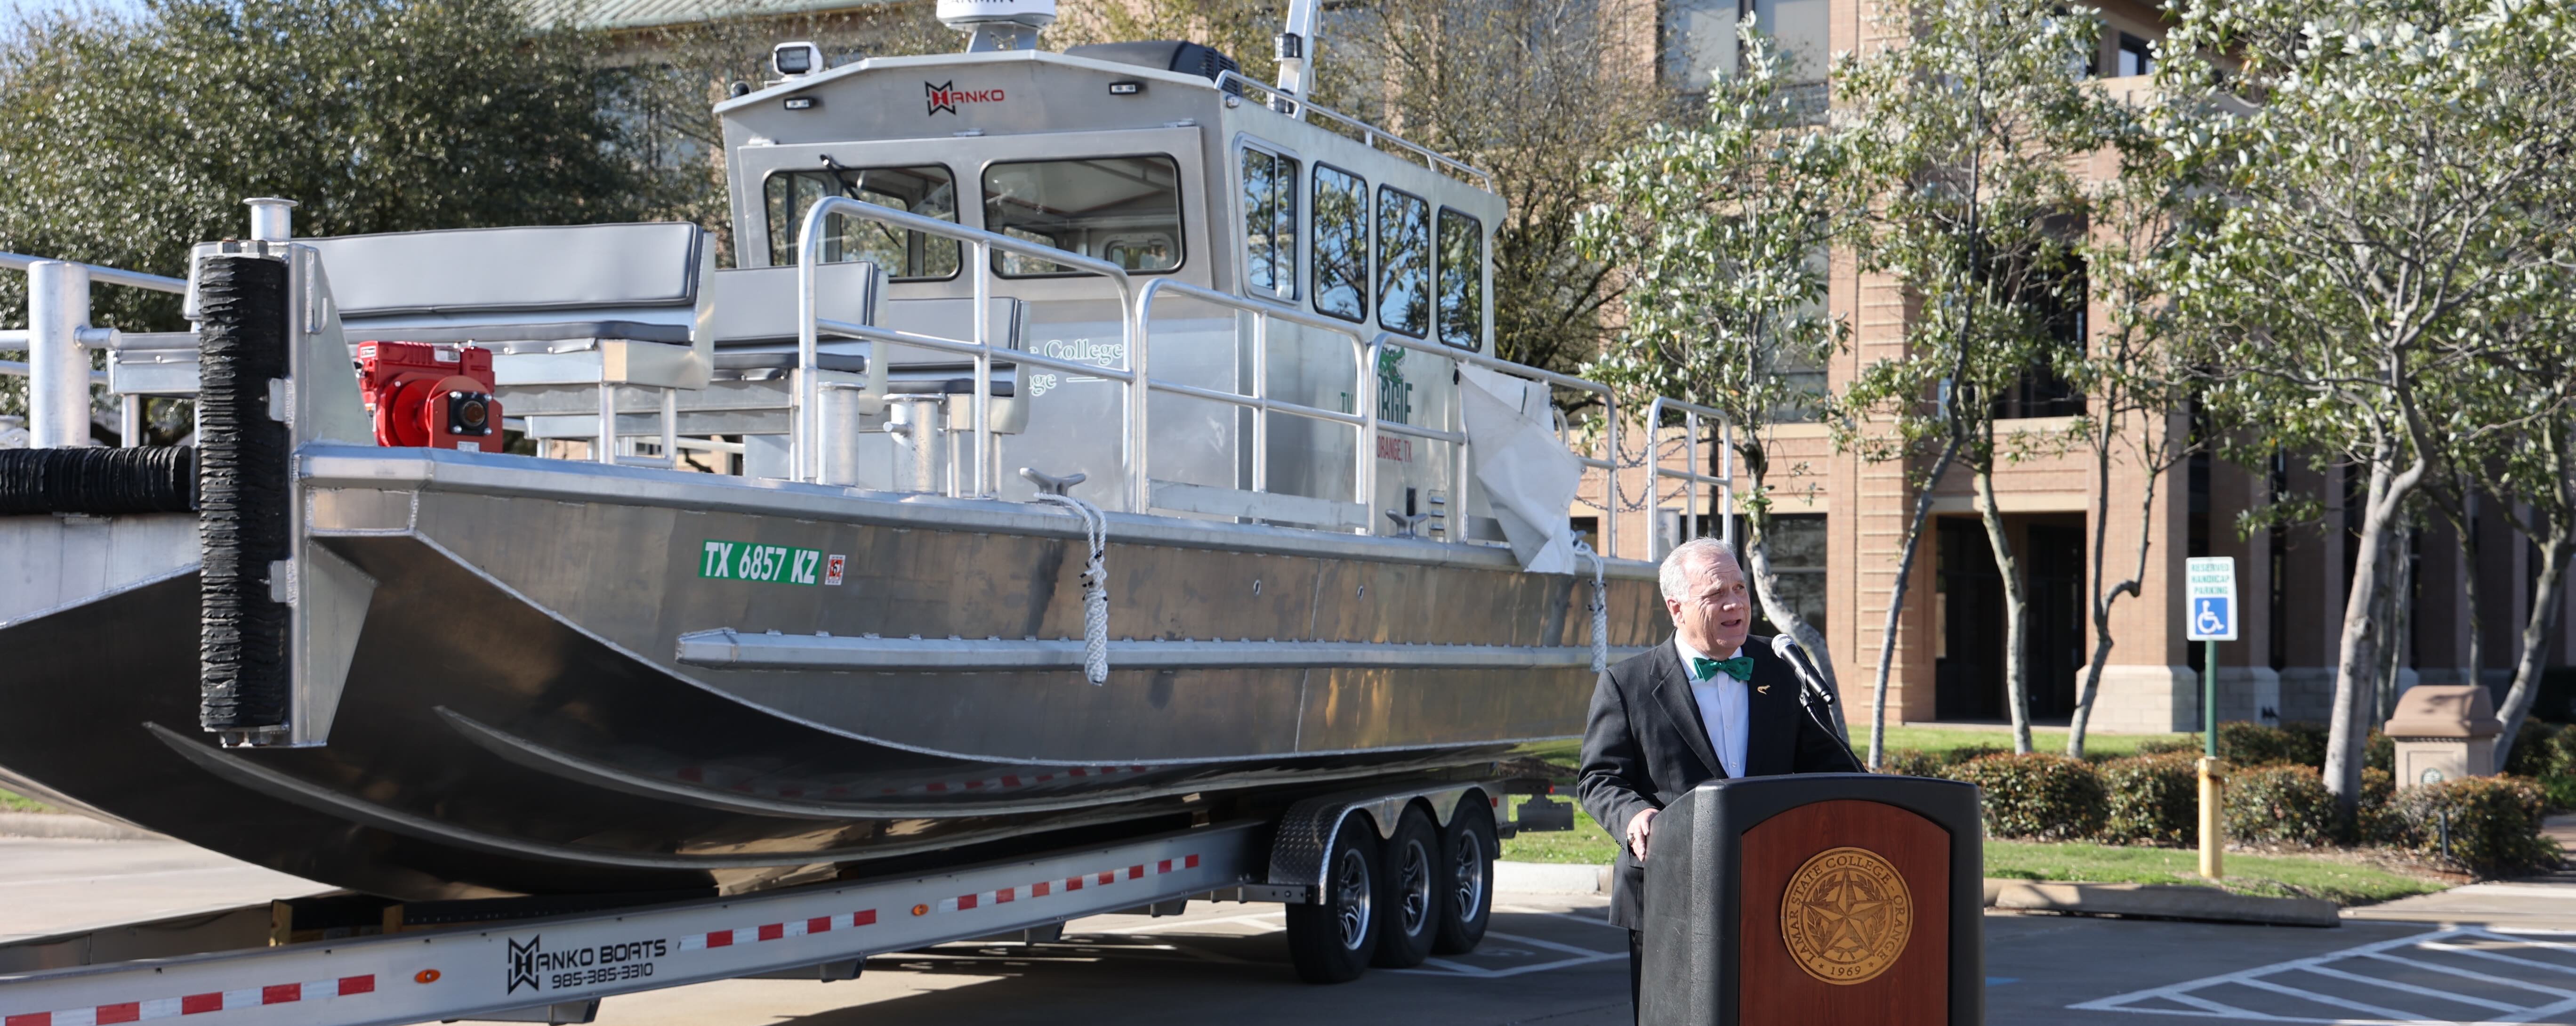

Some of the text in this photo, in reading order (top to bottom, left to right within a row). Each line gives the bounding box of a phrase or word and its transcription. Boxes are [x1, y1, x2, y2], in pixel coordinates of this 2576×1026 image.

[1044, 339, 1123, 366] College
[1404, 440, 1412, 463] TX
[705, 541, 820, 584] TX 6857 KZ
[2191, 564, 2229, 572] RESERVED
[2191, 575, 2230, 583] HANDICAP
[1825, 856, 1892, 884] COLLEGE
[1791, 864, 1823, 905] STATE
[1789, 910, 1816, 964] LAMAR
[1876, 895, 1905, 961] ORANGE
[600, 939, 667, 964] BOATS
[552, 962, 653, 988] 985-385-3310
[1830, 965, 1861, 976] 1969
